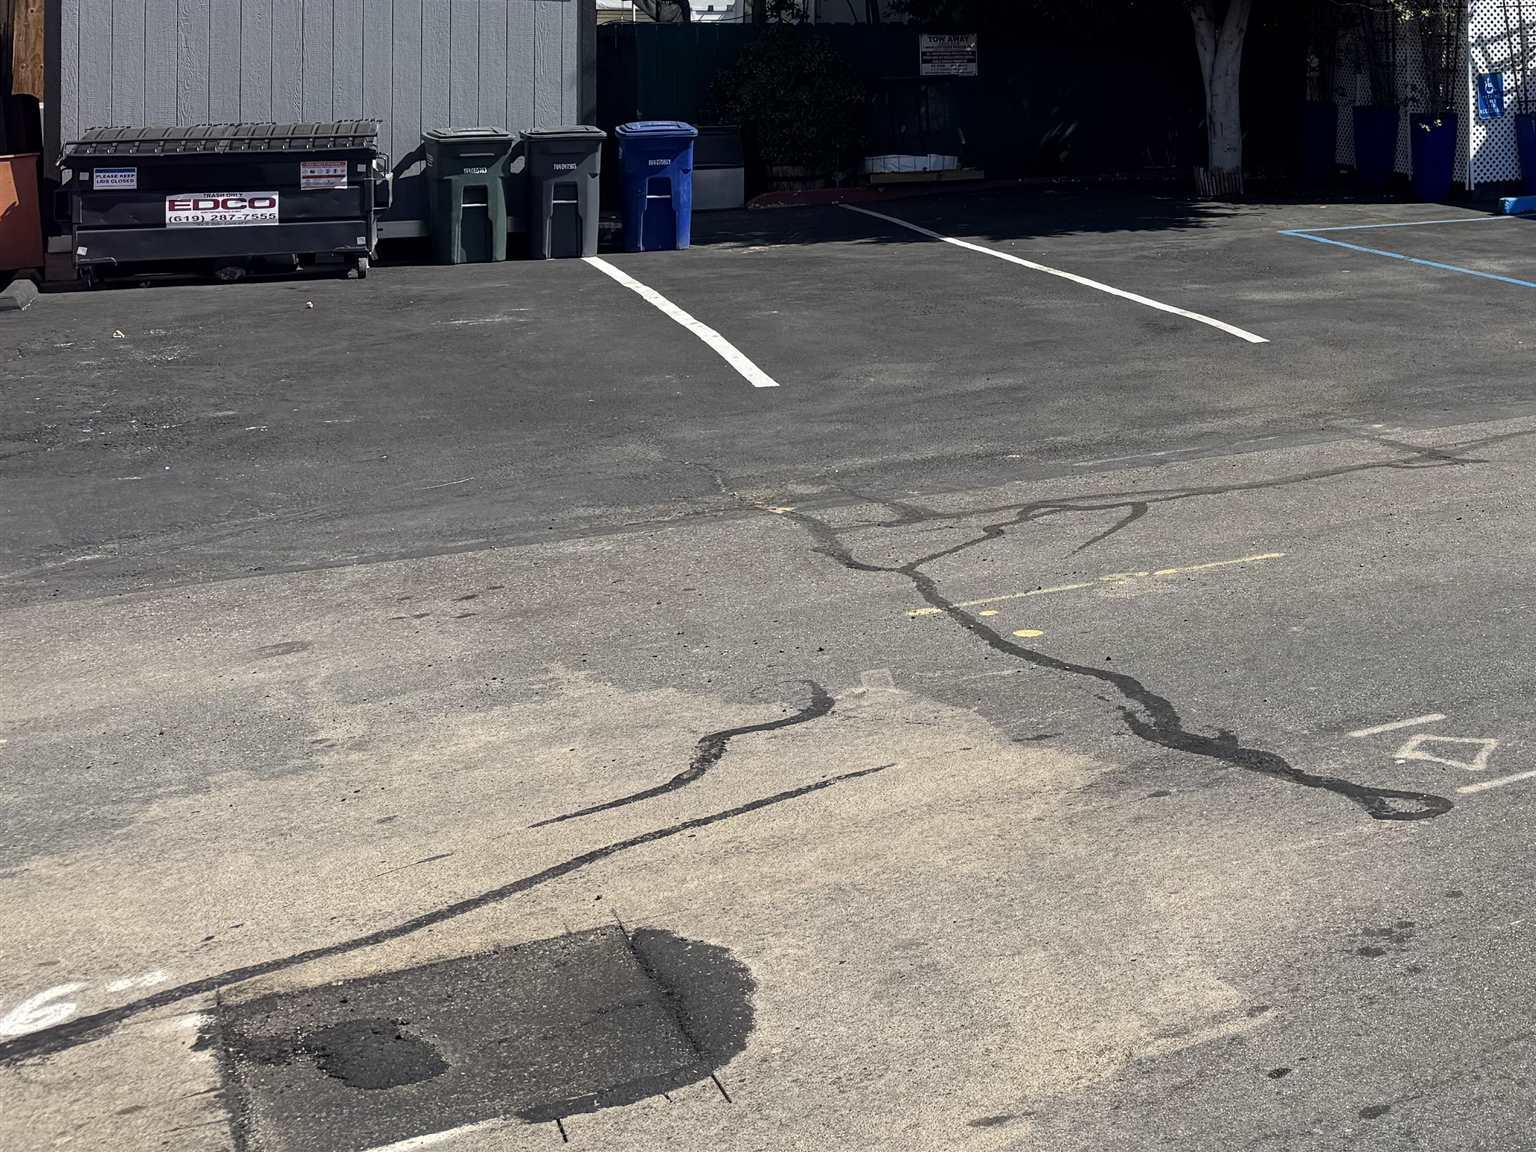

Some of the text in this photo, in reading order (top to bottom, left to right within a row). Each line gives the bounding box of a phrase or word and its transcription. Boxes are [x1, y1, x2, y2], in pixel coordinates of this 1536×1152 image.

[168, 197, 277, 212] EDCO
[168, 214, 205, 225] (619)
[207, 212, 276, 222] 287-7555
